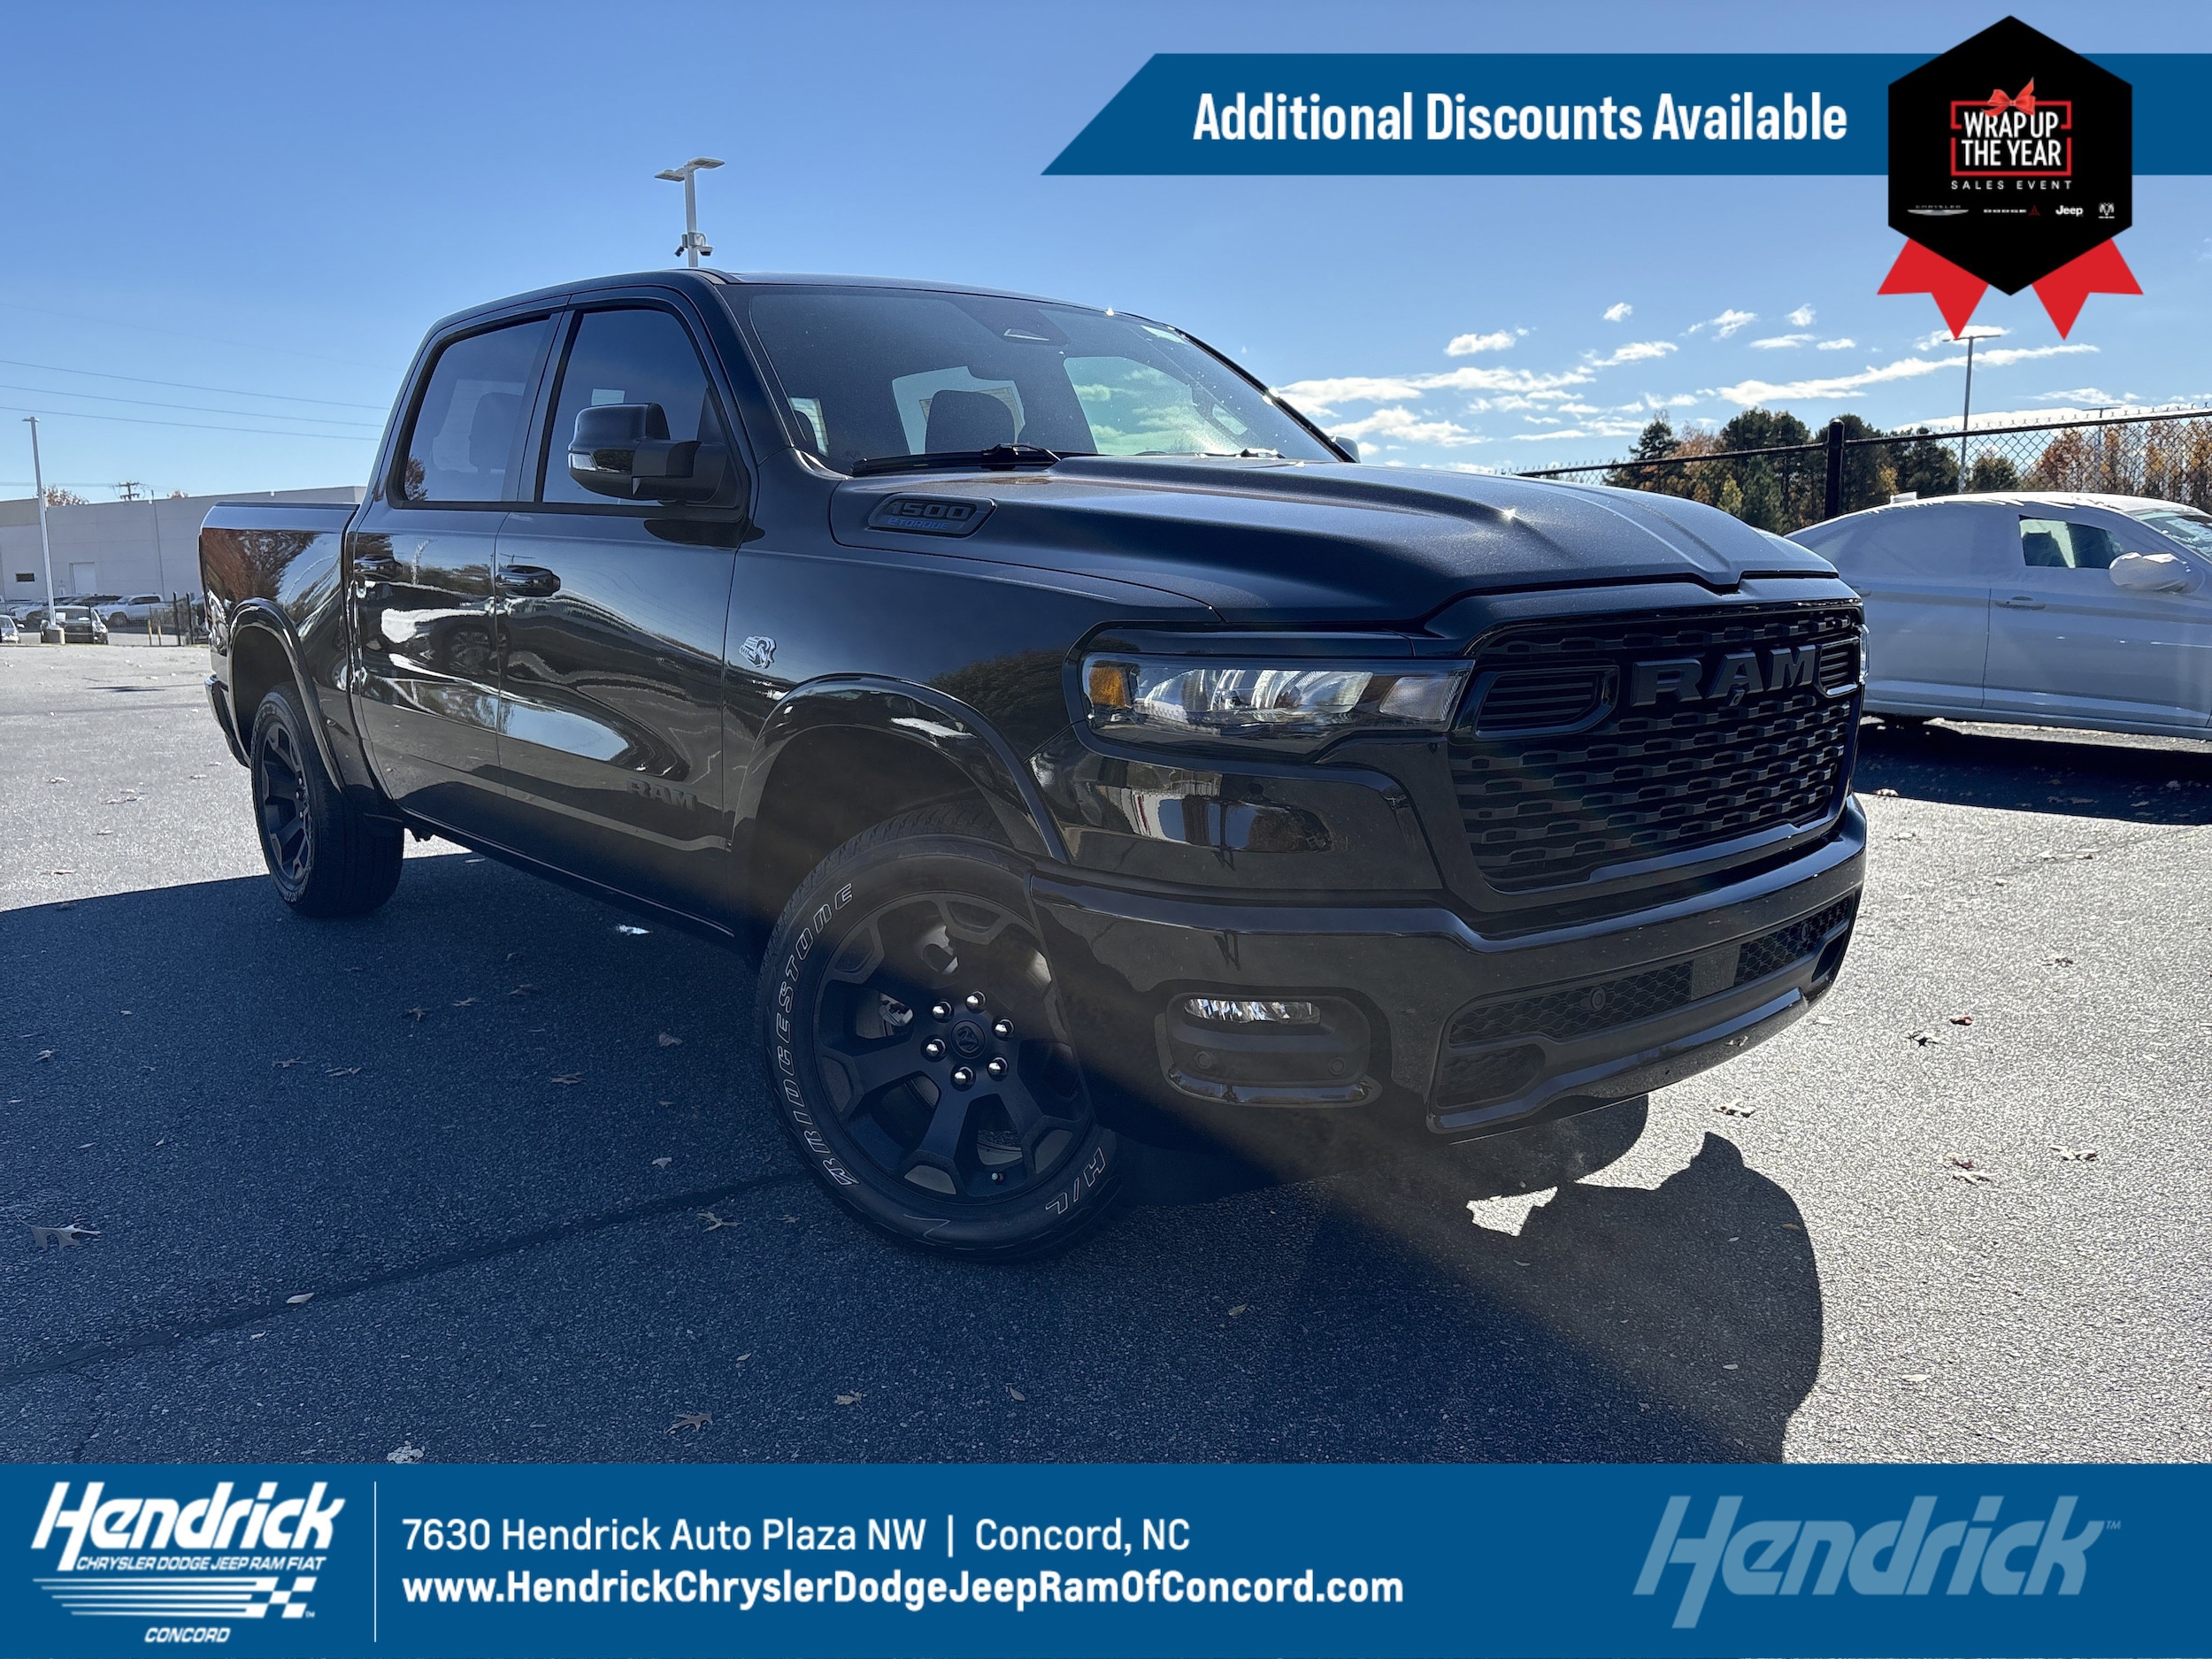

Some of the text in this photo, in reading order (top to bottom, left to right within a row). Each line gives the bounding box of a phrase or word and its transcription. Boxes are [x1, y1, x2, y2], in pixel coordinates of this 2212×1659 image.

[886, 501, 973, 520] 1500
[1631, 644, 1816, 708] RAM
[626, 777, 697, 811] RAM
[775, 882, 859, 1187] BRIDGESTONE
